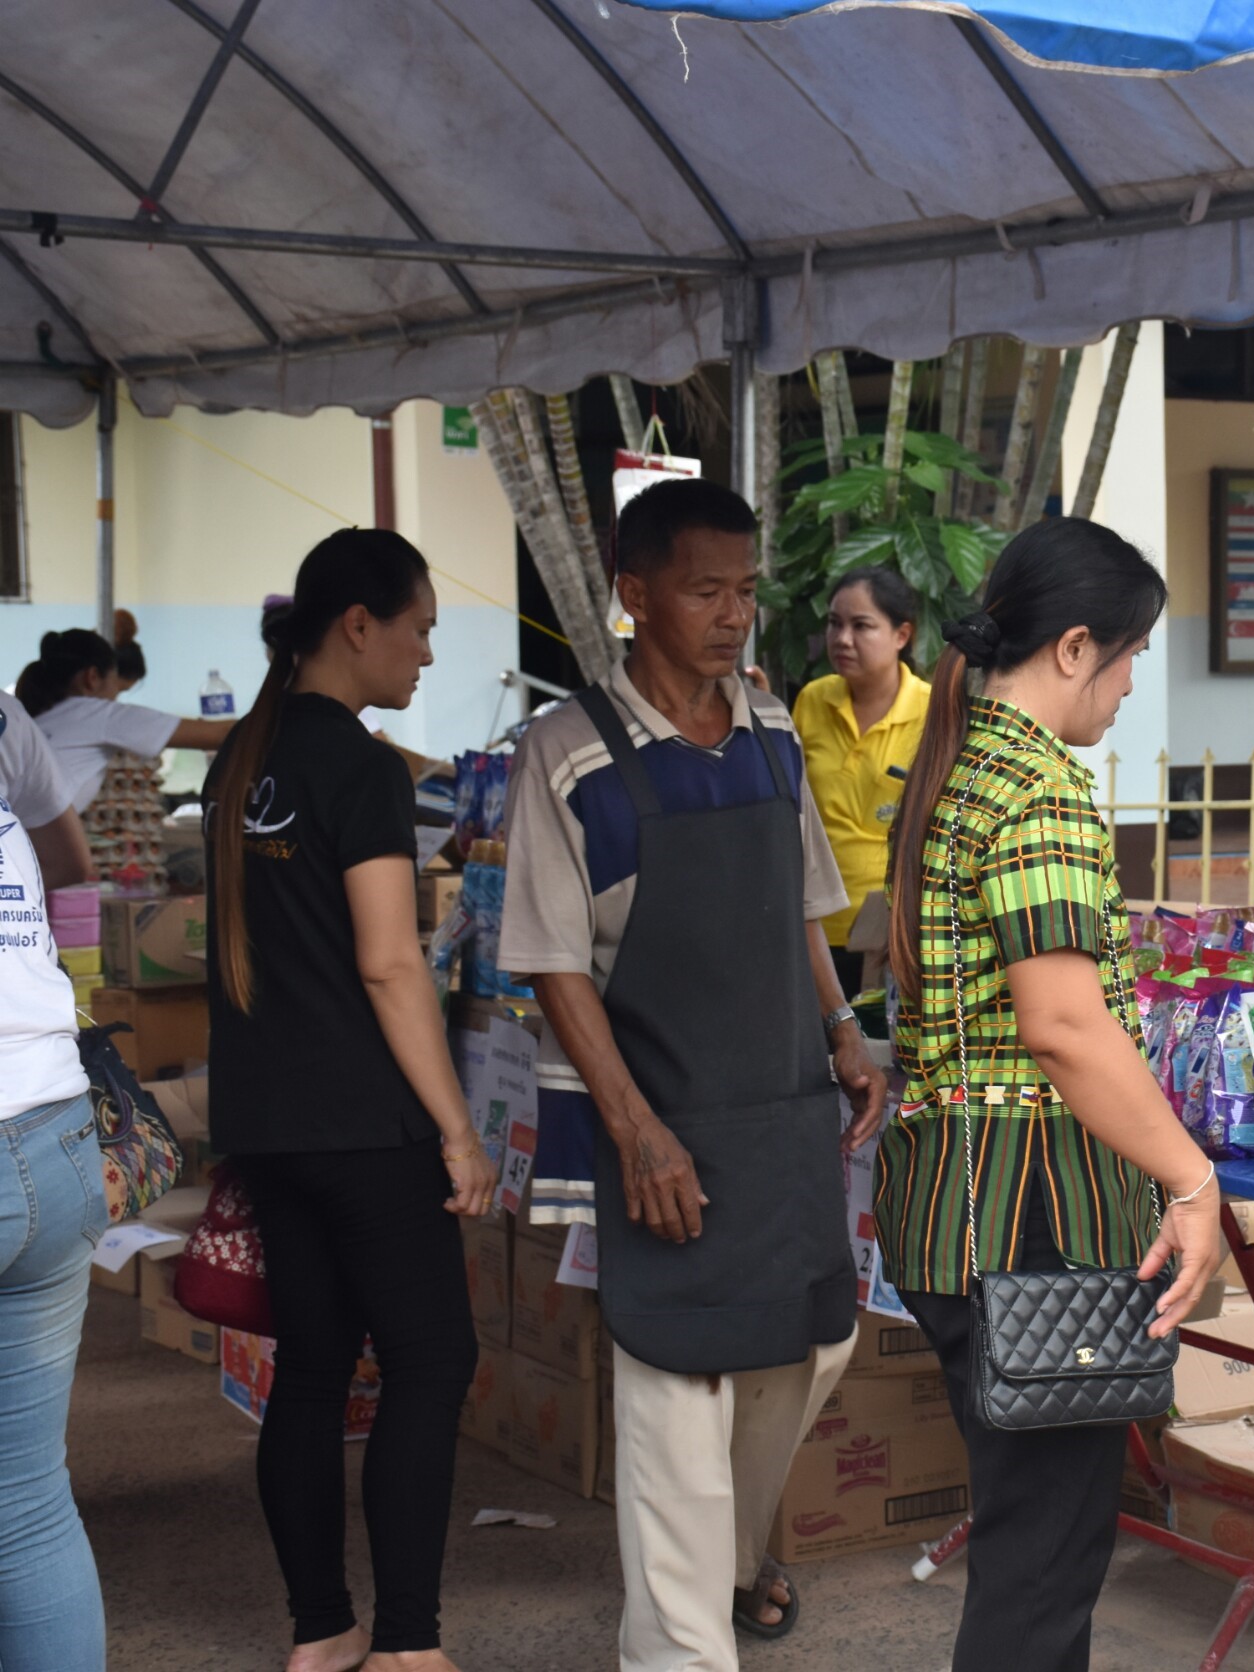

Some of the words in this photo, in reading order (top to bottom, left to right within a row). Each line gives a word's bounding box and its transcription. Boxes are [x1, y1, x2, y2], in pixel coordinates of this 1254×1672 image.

[0, 906, 43, 922] ครบครัน
[859, 1247, 872, 1273] 2
